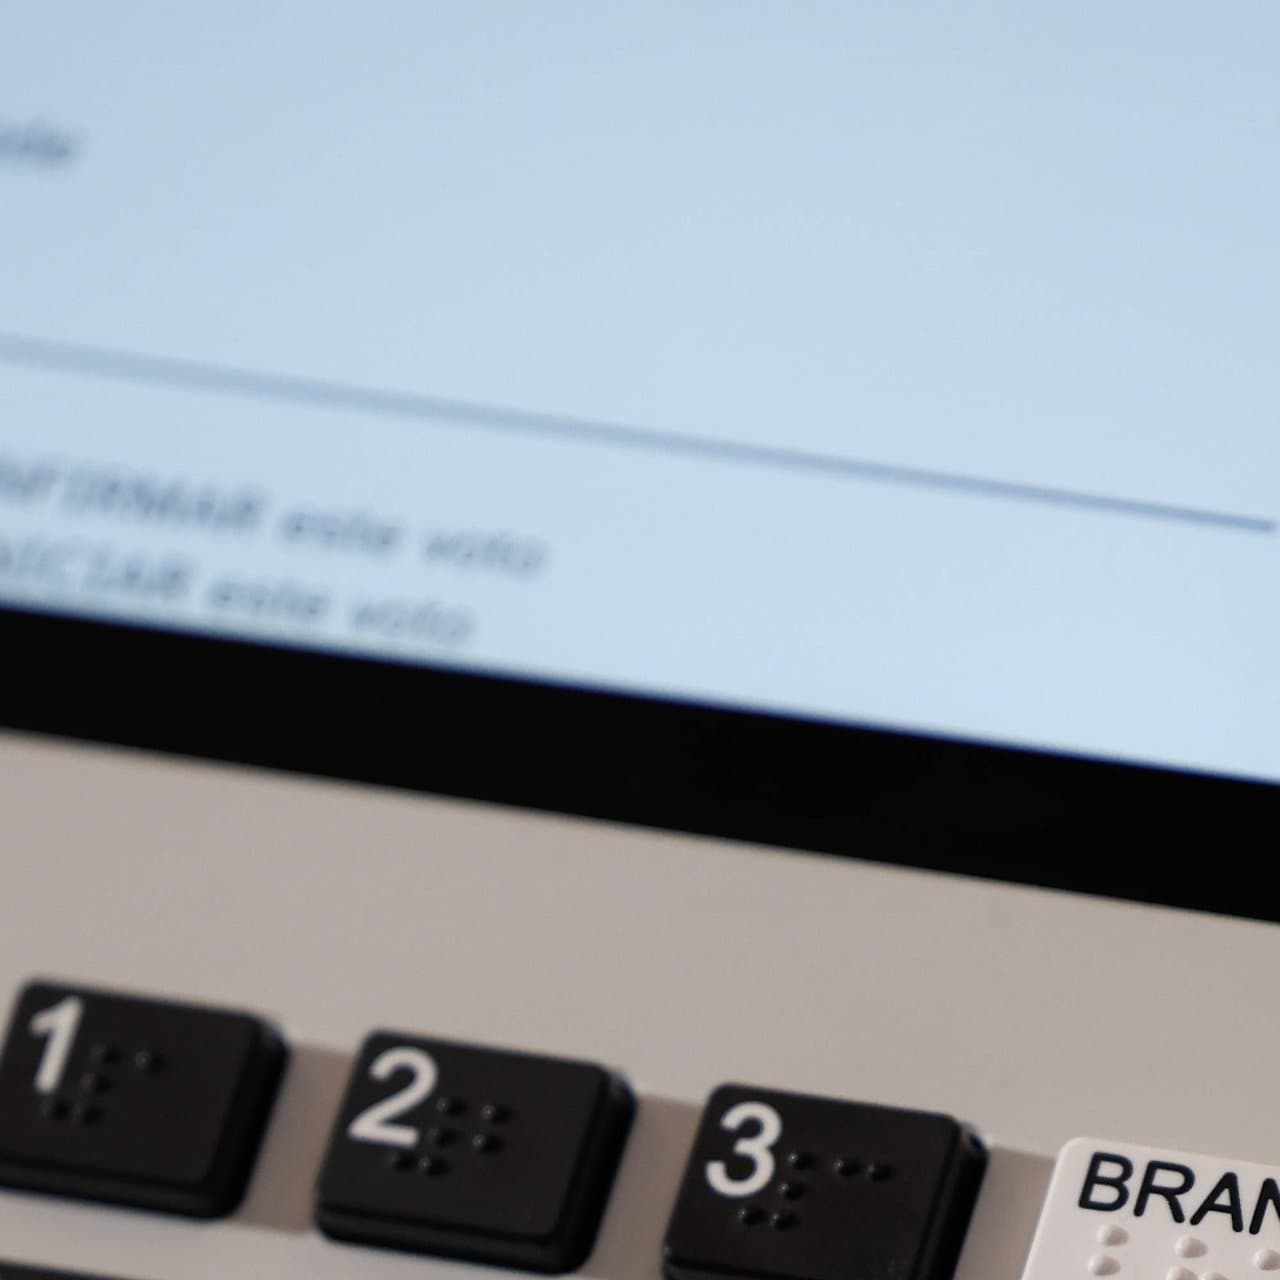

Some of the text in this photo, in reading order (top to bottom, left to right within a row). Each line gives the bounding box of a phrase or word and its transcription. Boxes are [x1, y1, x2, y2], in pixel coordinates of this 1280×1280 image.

[276, 503, 406, 559] este
[424, 526, 548, 579] voto
[207, 575, 332, 622] este
[345, 596, 477, 647] voto
[28, 998, 82, 1093] 1
[350, 1049, 436, 1146] 2
[707, 1103, 781, 1196] 3
